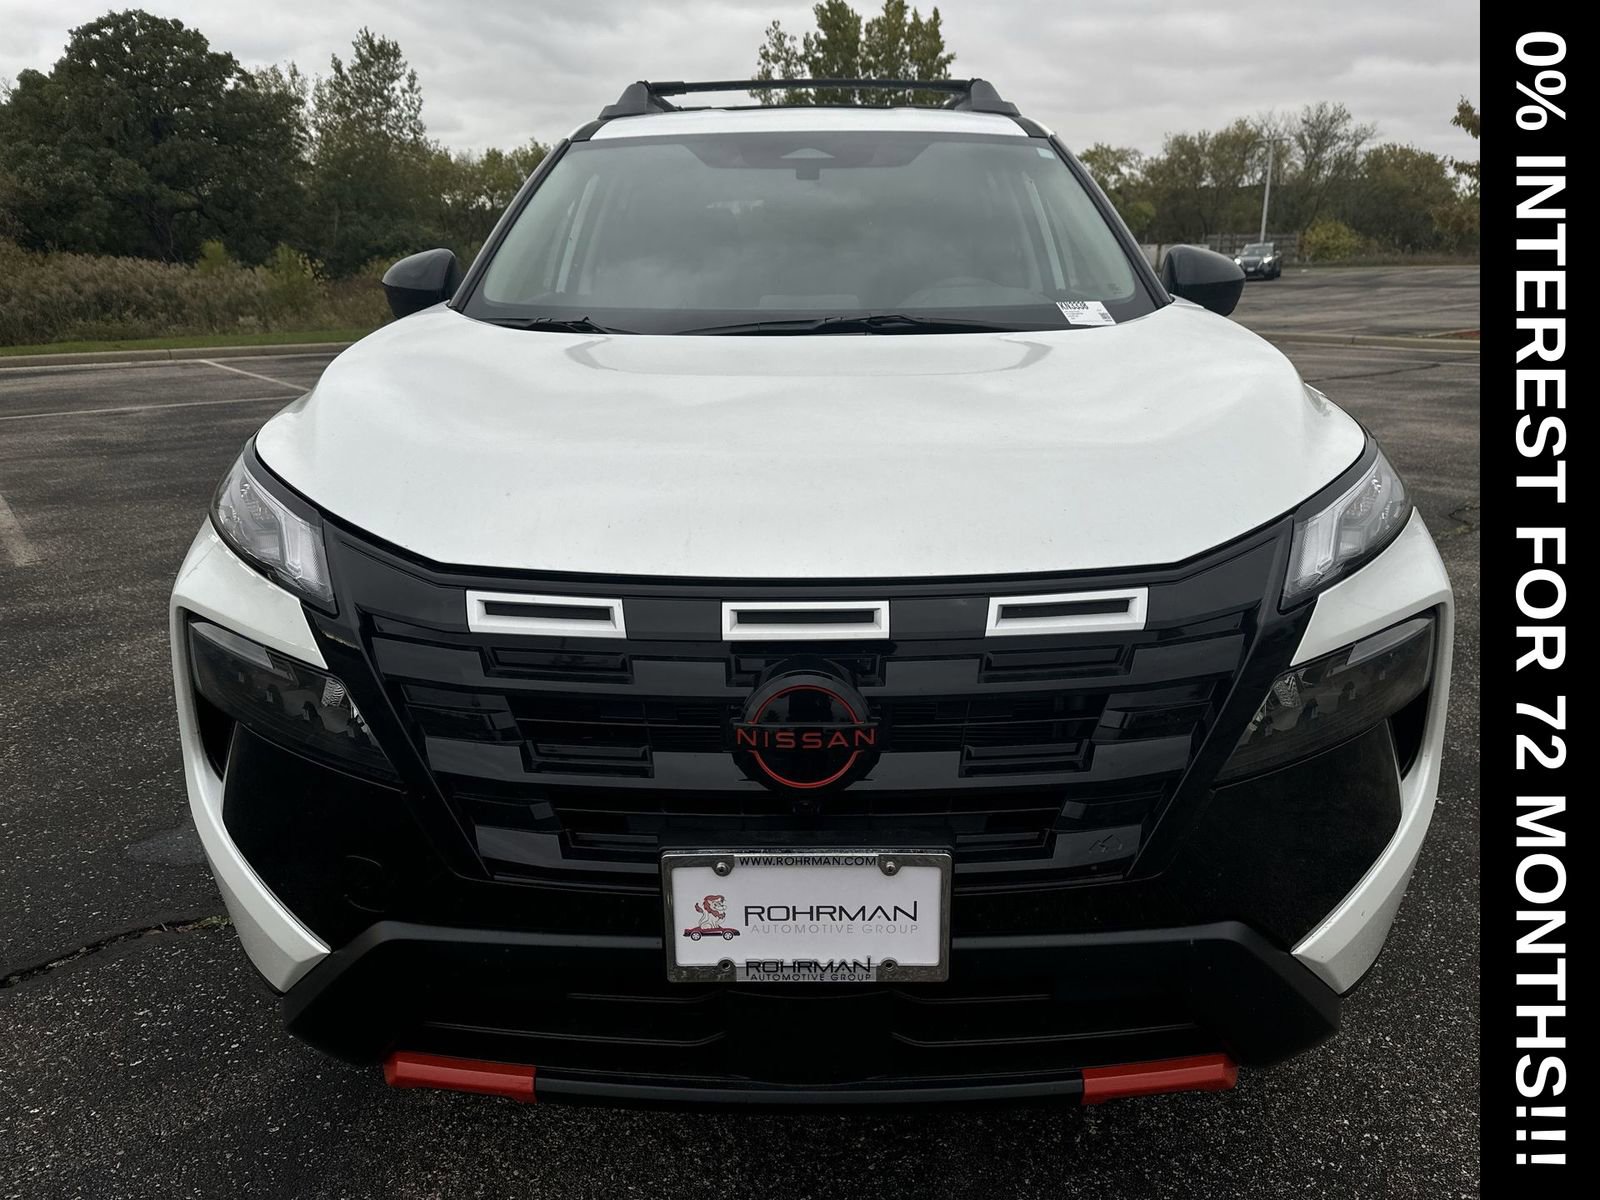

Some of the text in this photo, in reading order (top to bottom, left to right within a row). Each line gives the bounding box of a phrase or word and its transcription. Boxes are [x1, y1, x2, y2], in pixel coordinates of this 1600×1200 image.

[736, 728, 877, 749] NISSAN
[738, 856, 877, 867] WWW.ROHRMAN.COM
[744, 900, 918, 927] ROHRMAN
[750, 924, 919, 934] AUTOMOTIVE GROUP
[745, 956, 871, 977] ROHRMAN
[750, 973, 872, 982] AUTOMOTIVE GROUP
